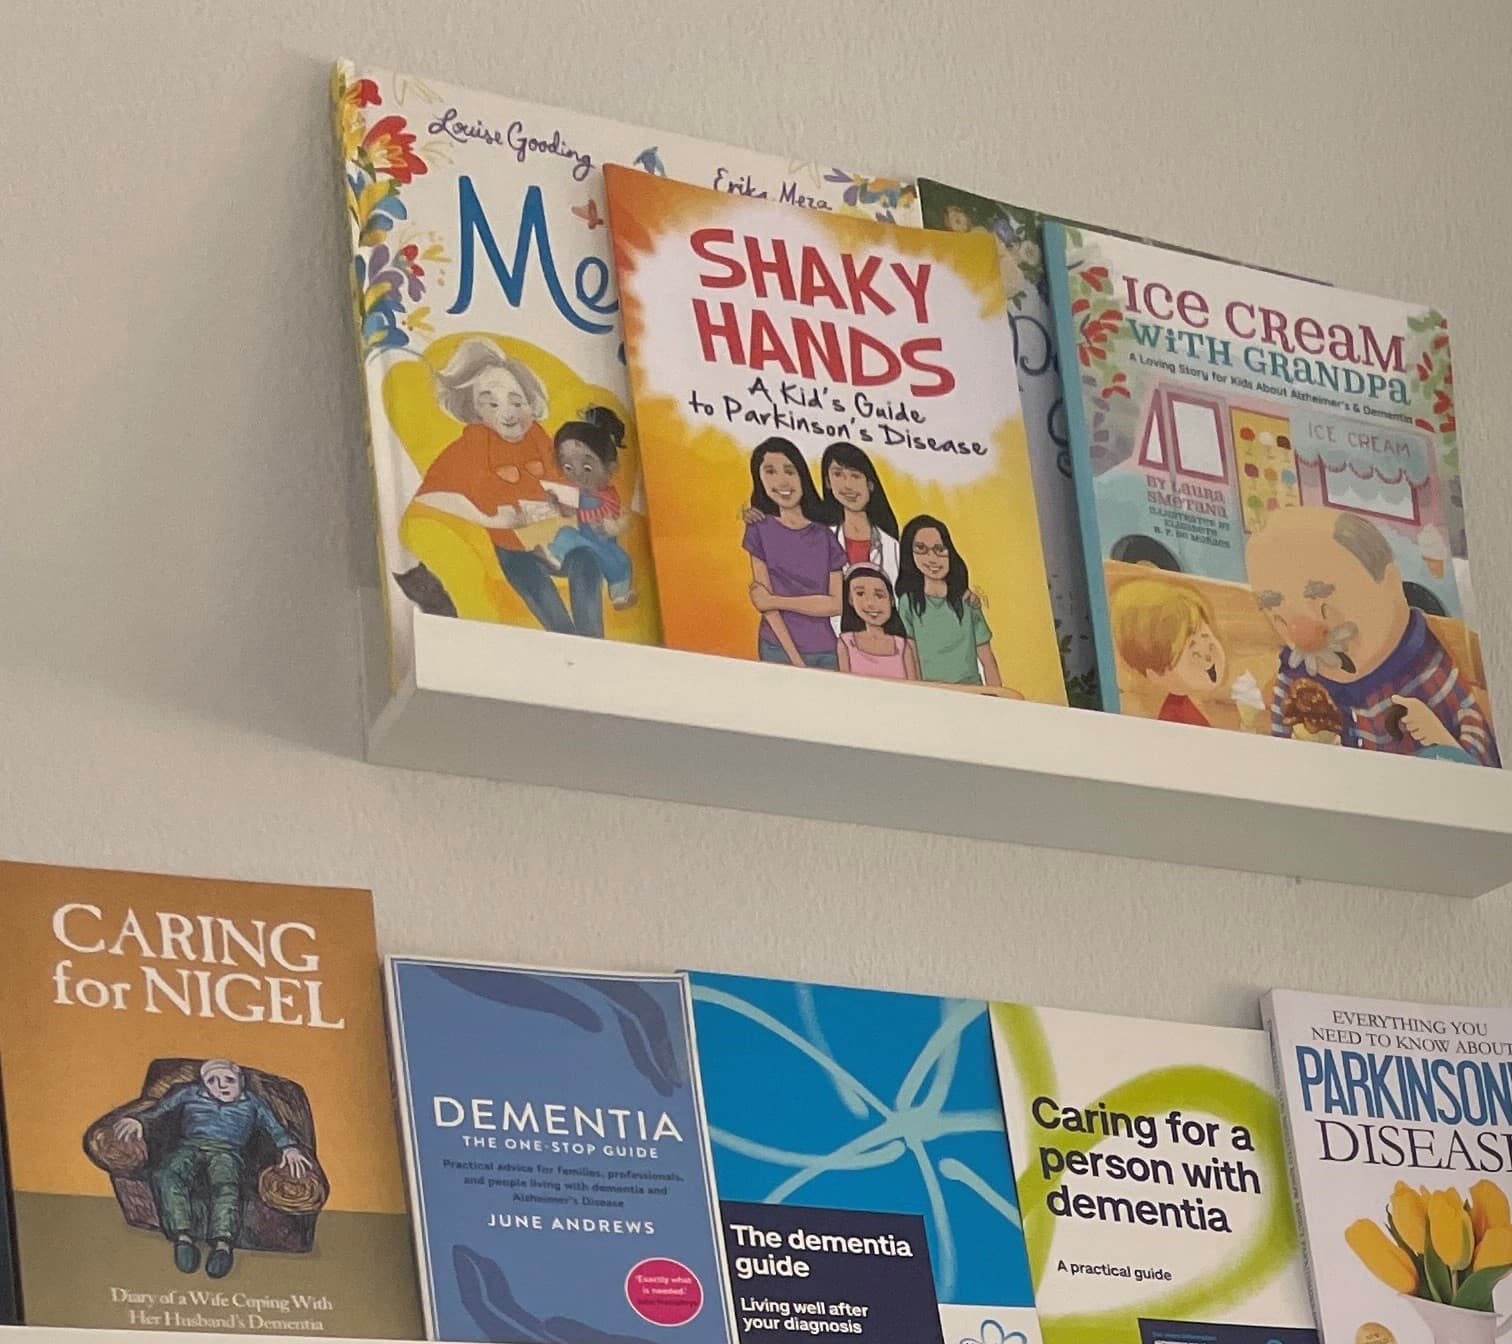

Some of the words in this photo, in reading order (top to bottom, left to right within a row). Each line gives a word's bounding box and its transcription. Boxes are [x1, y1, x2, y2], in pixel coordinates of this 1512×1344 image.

[429, 109, 503, 145] Louise
[507, 121, 594, 180] Gooding
[690, 229, 931, 323] SHAKY
[692, 299, 955, 397] HANDS
[749, 378, 772, 402] A
[780, 382, 845, 413] Kid's
[855, 393, 926, 423] Guide
[689, 392, 714, 417] to
[724, 396, 873, 442] Parkinson's
[880, 425, 988, 456] Disease
[53, 903, 320, 972] CARING
[53, 960, 130, 1010] for
[144, 967, 345, 1029] NIGEL
[1312, 1028, 1362, 1045] NEED
[1366, 1032, 1392, 1047] TO
[1395, 1036, 1450, 1053] KNOW
[1332, 1010, 1447, 1035] EVERYTHING
[1451, 1022, 1487, 1037] YOU
[433, 1096, 683, 1142] DEMENTIA
[1032, 1097, 1158, 1148] Caring
[1166, 1111, 1219, 1146] for
[1231, 1126, 1254, 1151] a
[463, 1135, 497, 1148] THE
[603, 1145, 658, 1158] GUIDE
[1040, 1146, 1174, 1185] person
[1183, 1158, 1260, 1194] with
[488, 1214, 542, 1229] JUNE
[552, 1218, 655, 1234] ANDREWS
[1046, 1186, 1232, 1233] dementia
[730, 1223, 782, 1248] The
[788, 1229, 913, 1257] dementia
[735, 1254, 810, 1279] guide
[1058, 1260, 1067, 1272] A
[1070, 1263, 1131, 1278] practical
[1135, 1267, 1172, 1281] guide
[741, 1298, 790, 1316] Living
[794, 1301, 825, 1315] well
[830, 1303, 868, 1318] after
[743, 1318, 779, 1332] your
[784, 1318, 862, 1335] diagnosis
